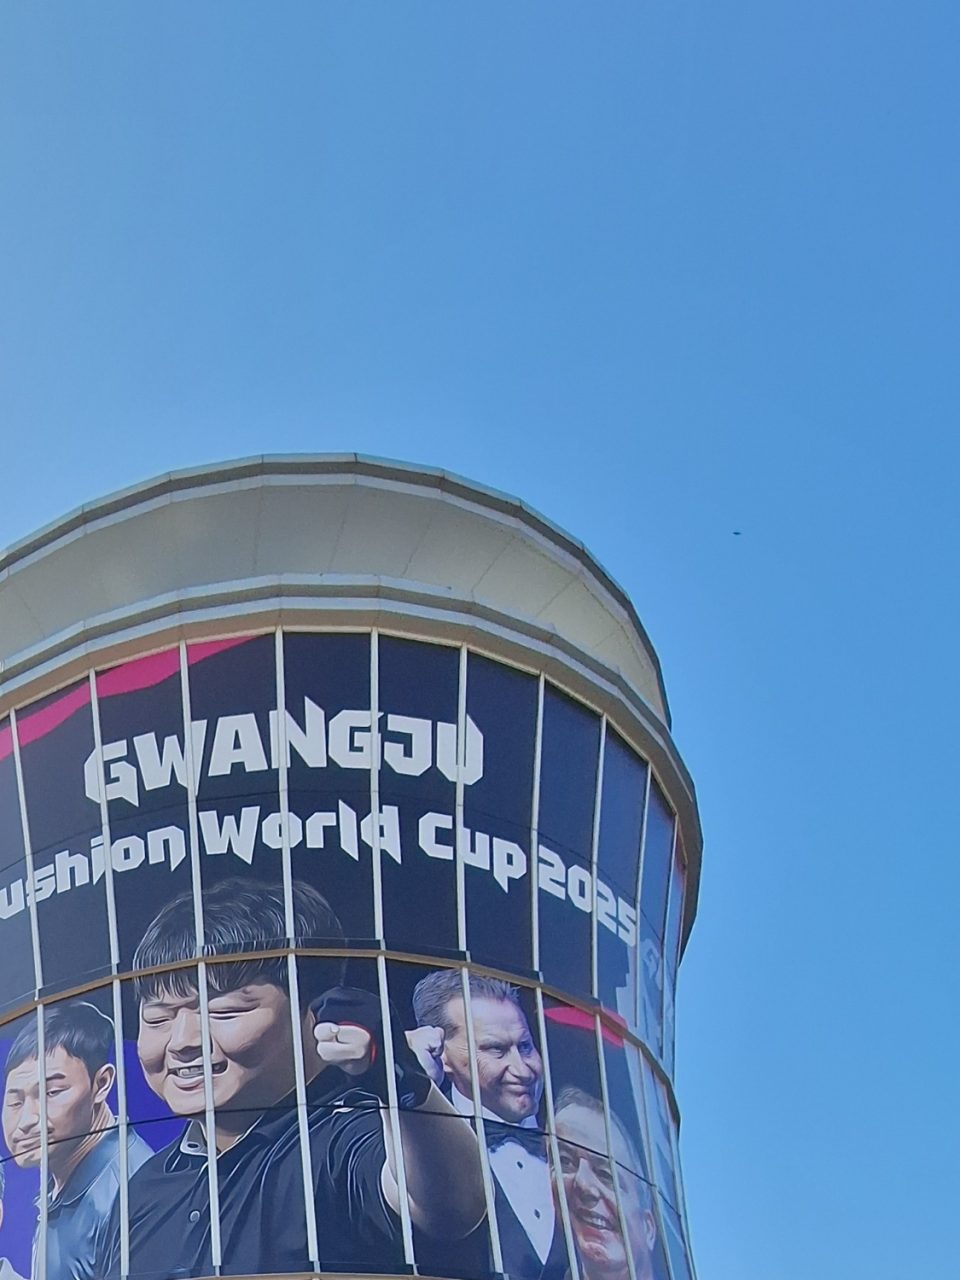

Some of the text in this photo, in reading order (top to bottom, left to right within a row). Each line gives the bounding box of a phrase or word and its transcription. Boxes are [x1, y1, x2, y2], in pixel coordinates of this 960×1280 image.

[84, 696, 483, 807] GWANGJU
[198, 800, 401, 865] World
[418, 812, 527, 893] Cup
[538, 844, 637, 947] 2025
